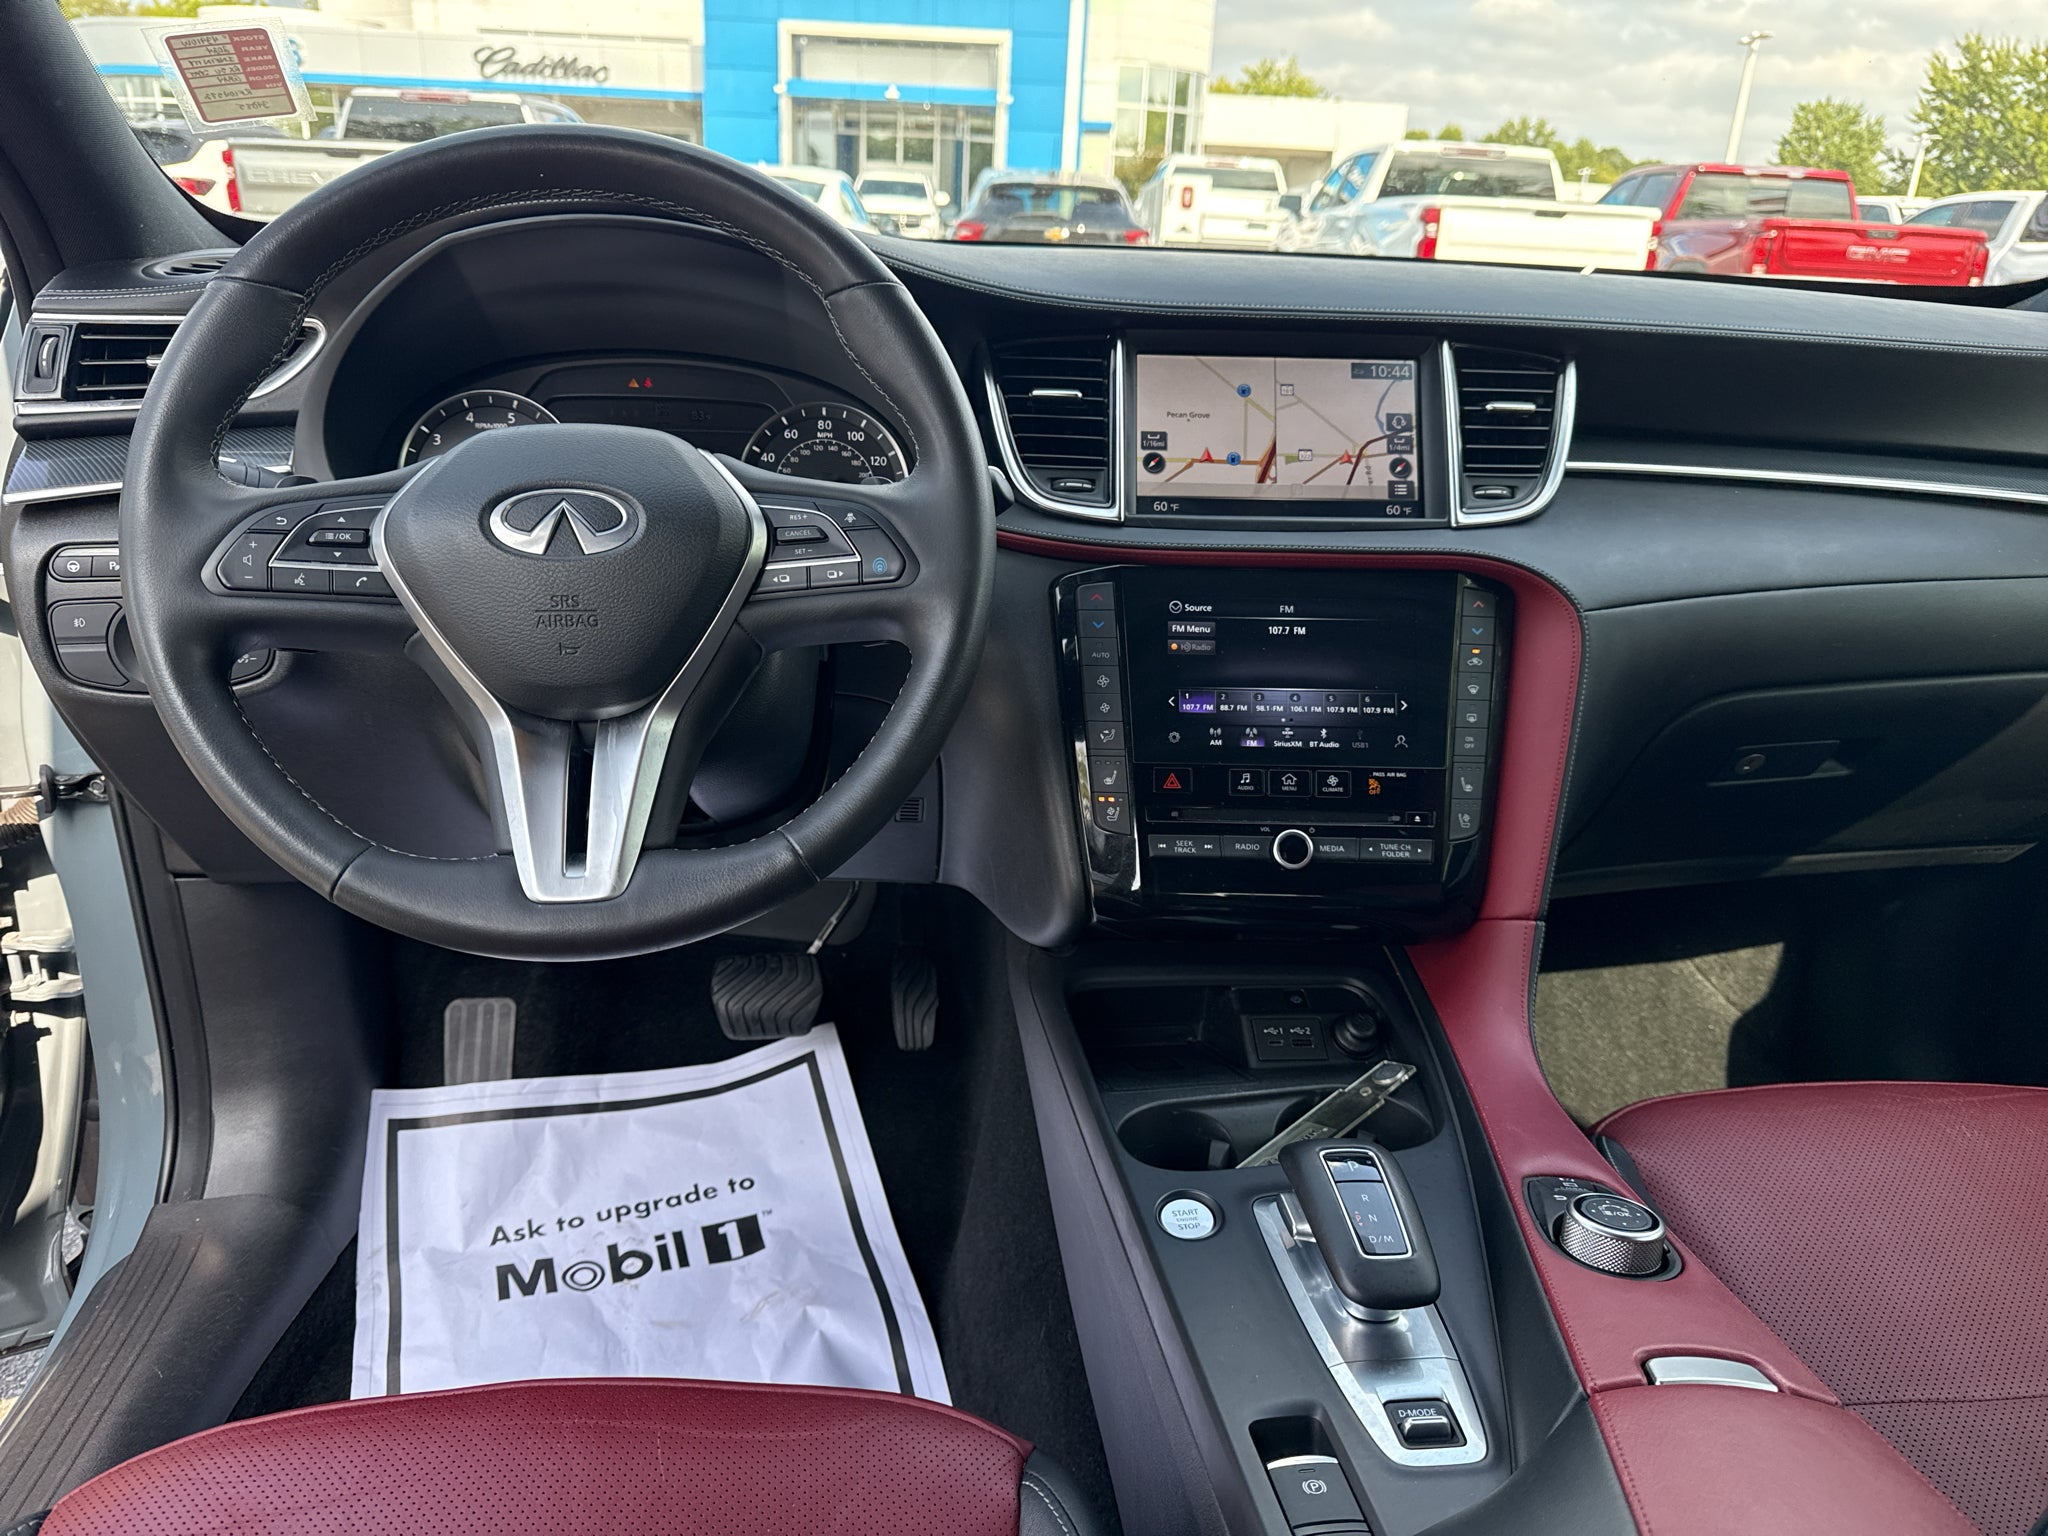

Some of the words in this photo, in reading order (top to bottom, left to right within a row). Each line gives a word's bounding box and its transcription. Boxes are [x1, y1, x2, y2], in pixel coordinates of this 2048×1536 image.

[473, 47, 610, 84] Cadillac
[1370, 365, 1410, 378] 10:44
[465, 412, 474, 424] 4
[507, 412, 516, 424] 5
[817, 420, 832, 430] 80
[784, 429, 798, 440] 60
[847, 431, 865, 442] 100
[433, 434, 442, 446] 3
[761, 453, 775, 462] 40
[870, 456, 887, 466] 120
[1153, 501, 1168, 512] 60
[1386, 505, 1400, 516] 60
[551, 594, 580, 609] SRS
[1184, 604, 1213, 612] Source
[1279, 605, 1294, 614] FM
[536, 614, 598, 628] AIRBAG
[1172, 625, 1184, 633] FM
[1187, 625, 1211, 634] Menu
[1269, 626, 1290, 635] 107.7
[1293, 626, 1306, 636] FM
[1273, 740, 1303, 748] SiriusXM
[1347, 1160, 1359, 1172] P
[1361, 1194, 1370, 1202] R
[489, 1219, 546, 1247] Ask
[556, 1216, 584, 1233] to
[597, 1183, 718, 1224] upgrade
[727, 1177, 756, 1194] to
[1171, 1208, 1198, 1217] START
[1368, 1214, 1378, 1222] N
[1178, 1222, 1201, 1230] STOP
[1368, 1235, 1394, 1244] D/M
[496, 1230, 691, 1302] Mobil
[1398, 1408, 1438, 1418] D-MODE
